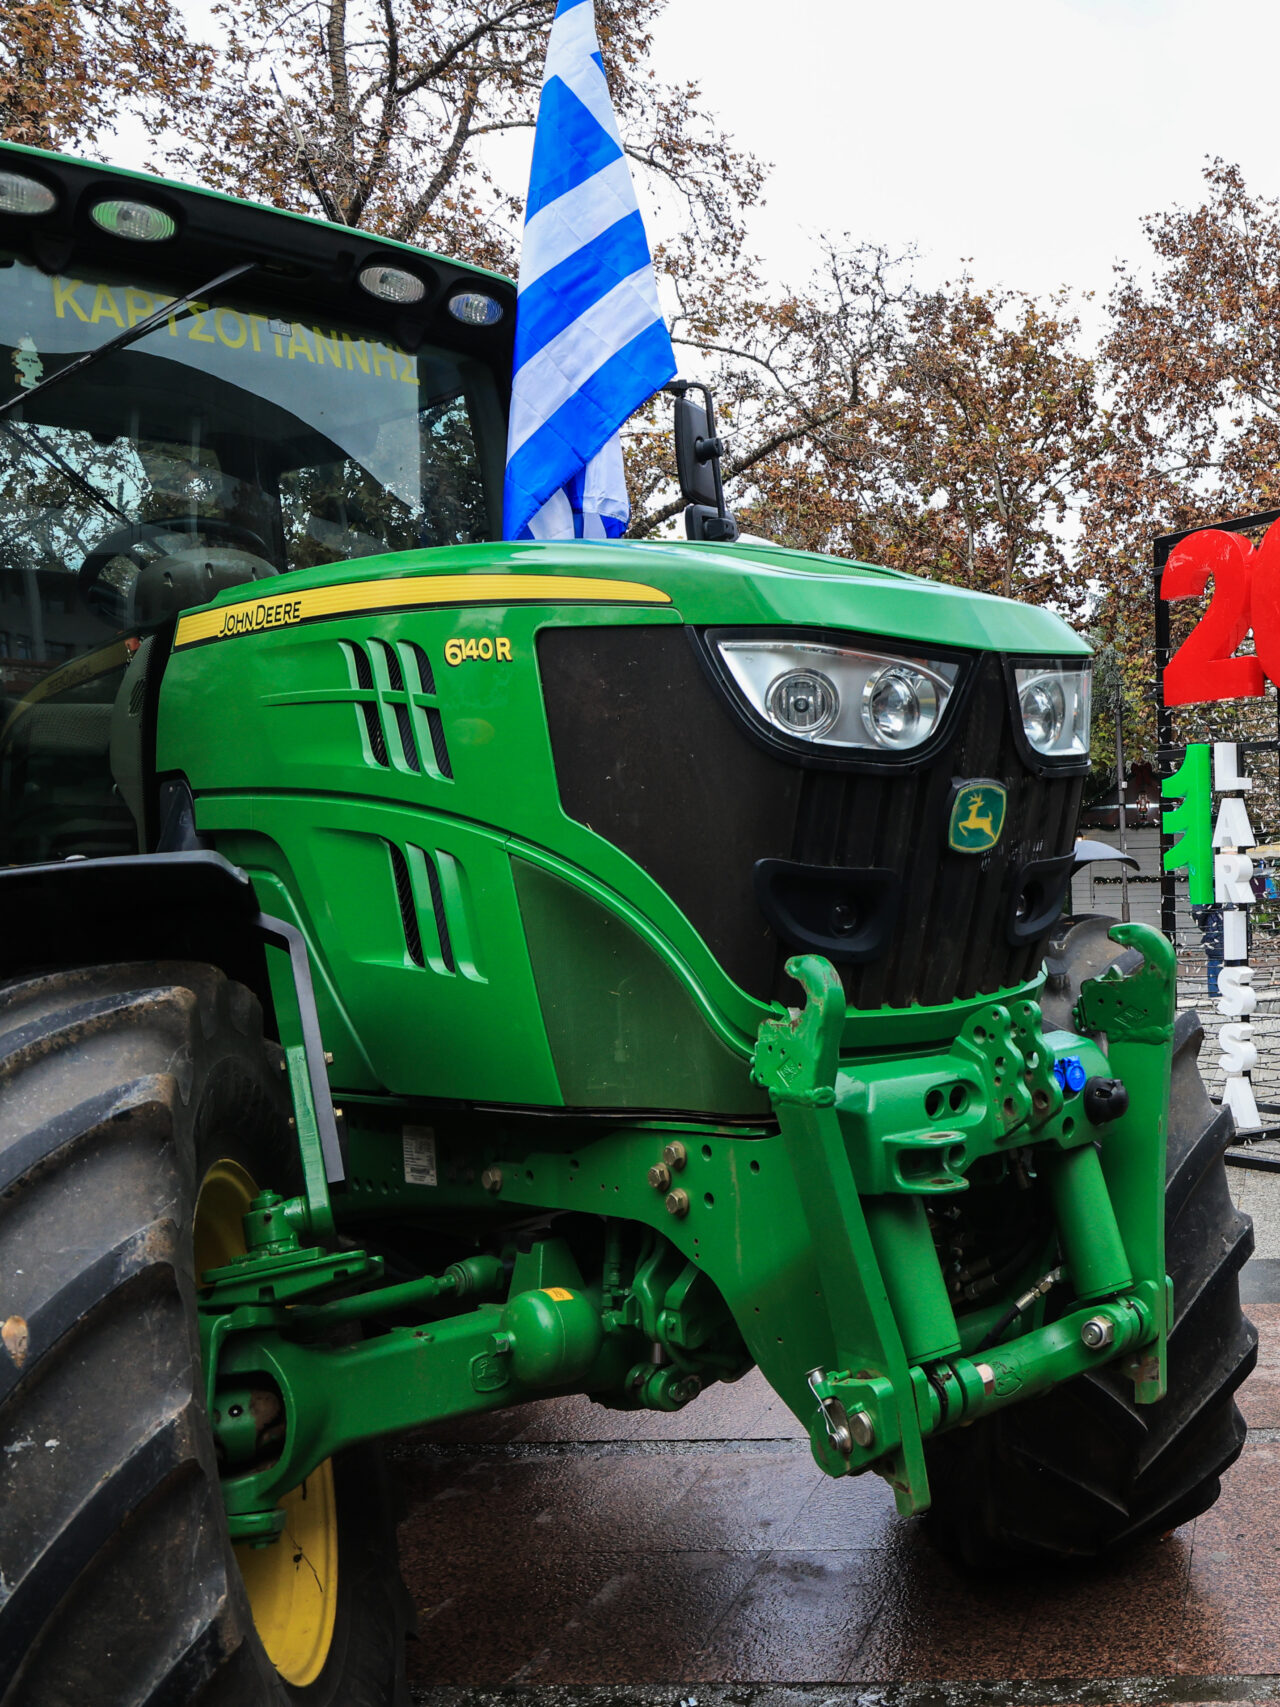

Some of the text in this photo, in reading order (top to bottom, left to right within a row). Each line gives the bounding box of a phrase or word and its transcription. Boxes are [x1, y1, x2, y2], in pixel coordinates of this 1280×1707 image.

[219, 601, 302, 634] JOHN DEERE
[1212, 742, 1262, 1130] LARISSA
